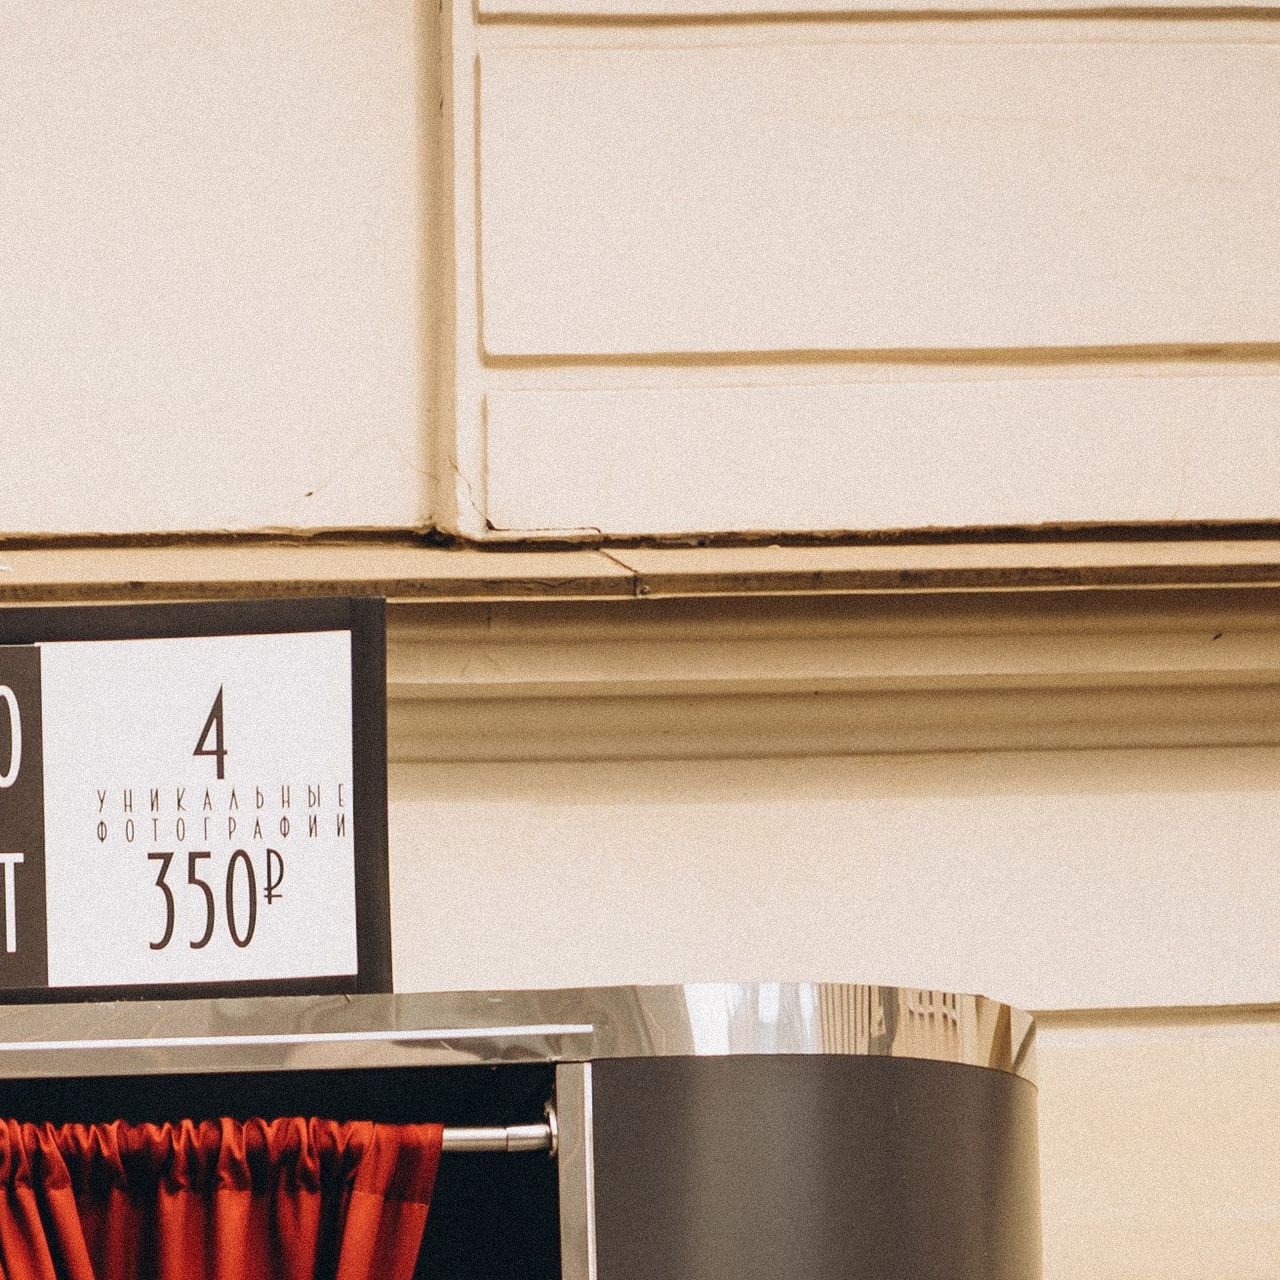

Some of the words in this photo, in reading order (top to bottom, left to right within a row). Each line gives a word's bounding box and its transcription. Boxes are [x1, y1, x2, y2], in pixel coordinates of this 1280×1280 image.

[193, 684, 228, 780] 4
[96, 784, 345, 812] УНИКАЛЬНЫЕ
[96, 813, 346, 843] ФОТОГРАФИИ
